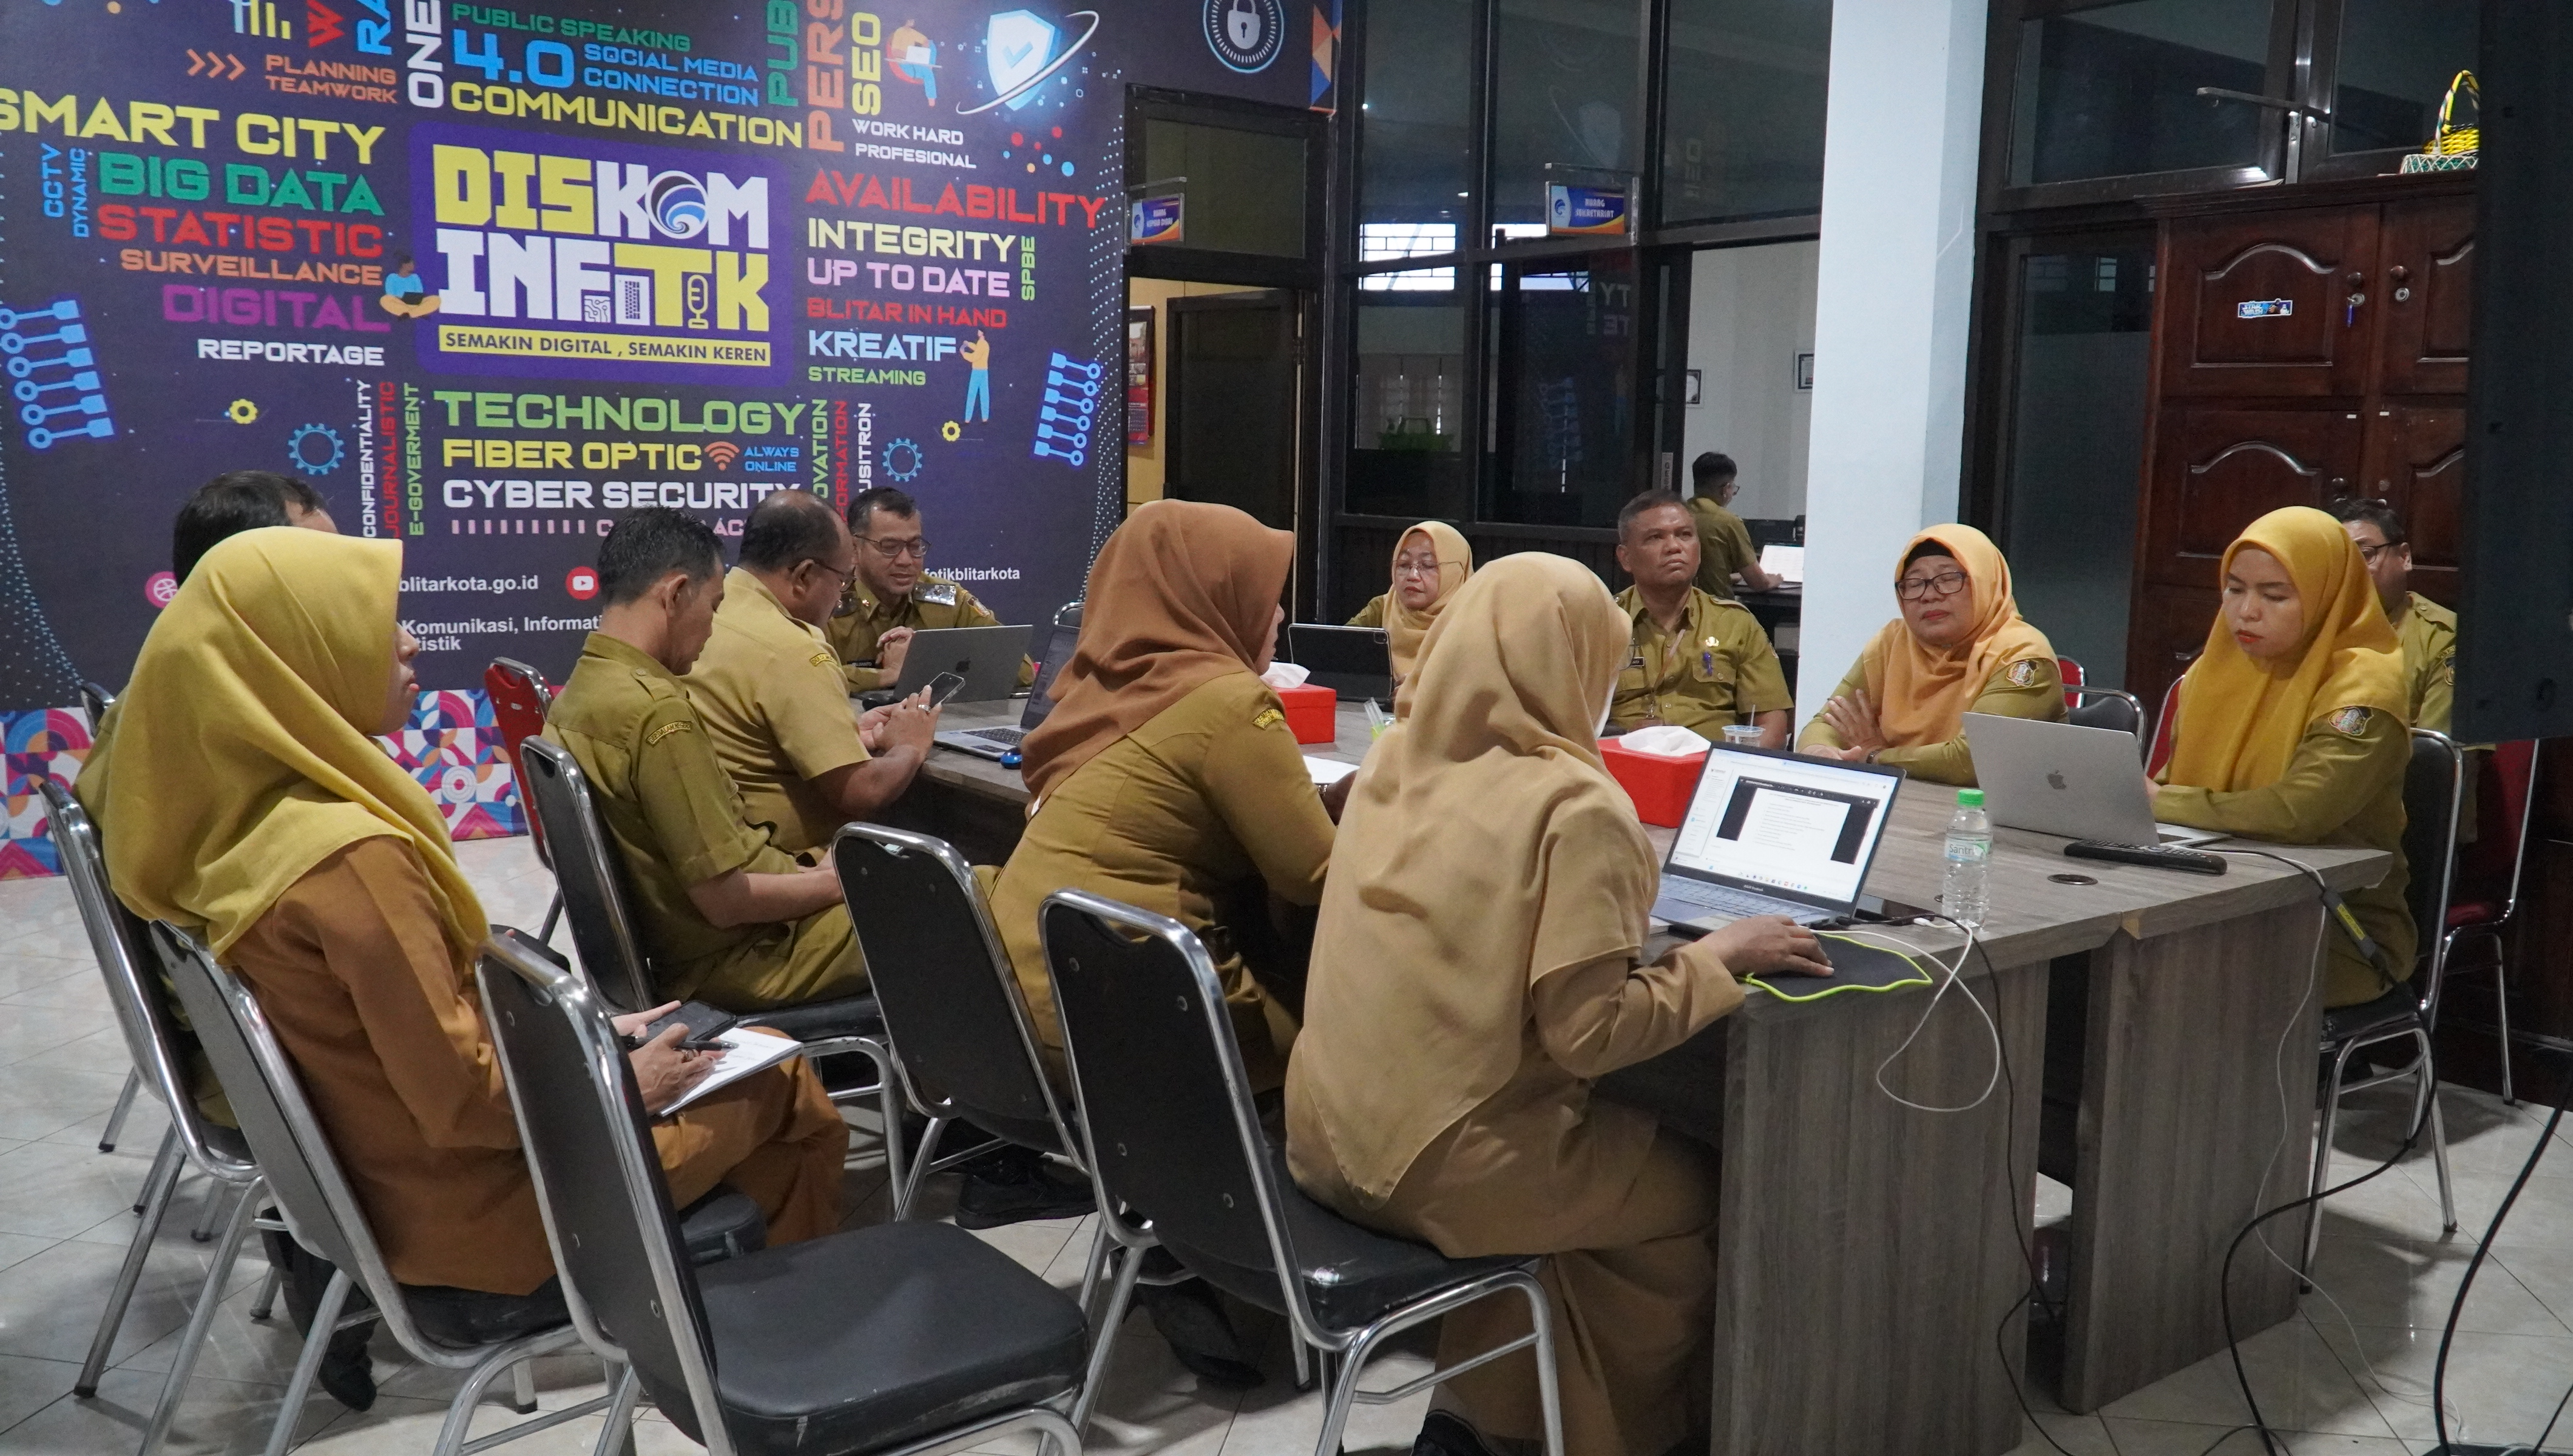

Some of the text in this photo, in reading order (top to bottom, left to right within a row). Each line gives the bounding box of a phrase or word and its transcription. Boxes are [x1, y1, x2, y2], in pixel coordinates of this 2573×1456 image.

[452, 3, 691, 52] PUBLIC SPEAKING
[265, 54, 397, 85] PLANNING
[453, 29, 575, 89] 4.0
[584, 43, 759, 83] SOCIAL MEDIA
[852, 12, 881, 115] SEO
[265, 75, 397, 104] TEAMWORK
[583, 66, 759, 107] CONNECTION
[451, 82, 802, 148] COMMUNICATION
[852, 119, 964, 146] WORK HARD
[236, 112, 385, 164] CITY
[855, 143, 976, 169] PROFESIONAL
[41, 143, 64, 218] CCTV
[70, 147, 90, 238] DYNAMIC
[99, 152, 385, 217] BIG DATA
[805, 168, 1106, 229] AVAILABILITY
[97, 204, 383, 257] STATISTIC
[808, 218, 1016, 262] INTEGRITY
[121, 248, 383, 286] SURVEILLANCE
[807, 257, 1010, 297] UP TO DATE
[1021, 235, 1035, 301] SPBE
[163, 284, 391, 332] DIGITAL
[807, 297, 1007, 328] BLITAR IN HAND
[198, 339, 385, 366] REPORTAGE
[445, 332, 533, 350] SEMAKIN
[629, 342, 706, 359] SEMAKIN
[714, 346, 766, 362] KEREN
[809, 329, 956, 361] KREATIF
[808, 366, 925, 385] STREAMING
[433, 391, 806, 435] TECHNOLOGY
[357, 379, 376, 538] CONFIDENTIALITY
[379, 382, 401, 538] JOURNALISTIC
[404, 382, 424, 536] E-GOVERMENT
[443, 439, 702, 472] FIBER OPTIC
[744, 445, 799, 458] ALWAYS
[745, 460, 797, 472] ONLINE
[443, 479, 800, 508] CYBER SECURIT
[402, 618, 518, 635] Komunikasi,
